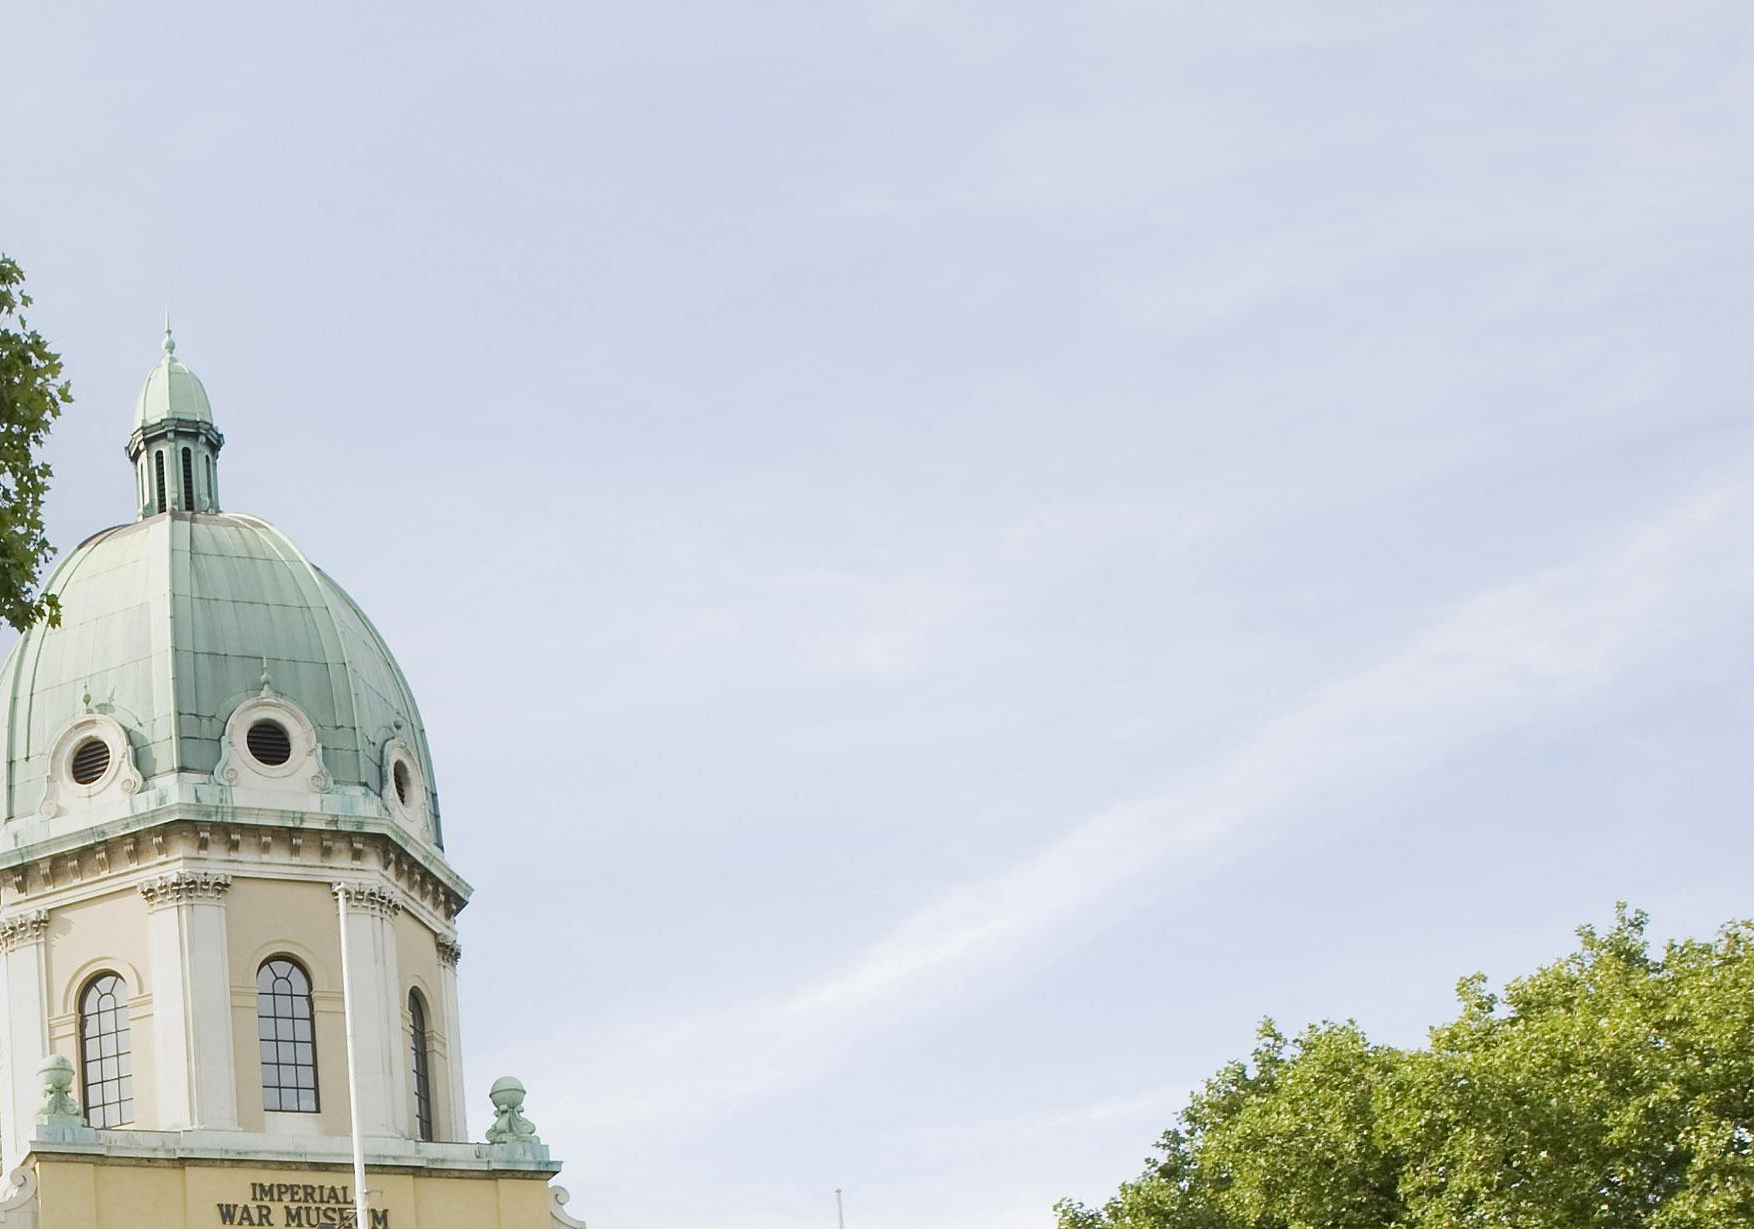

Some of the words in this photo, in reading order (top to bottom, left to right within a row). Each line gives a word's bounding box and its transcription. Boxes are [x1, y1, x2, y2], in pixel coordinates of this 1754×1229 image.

[251, 1182, 354, 1204] IMPERIAL
[217, 1203, 274, 1227] WAR
[284, 1204, 389, 1229] MUSEM
